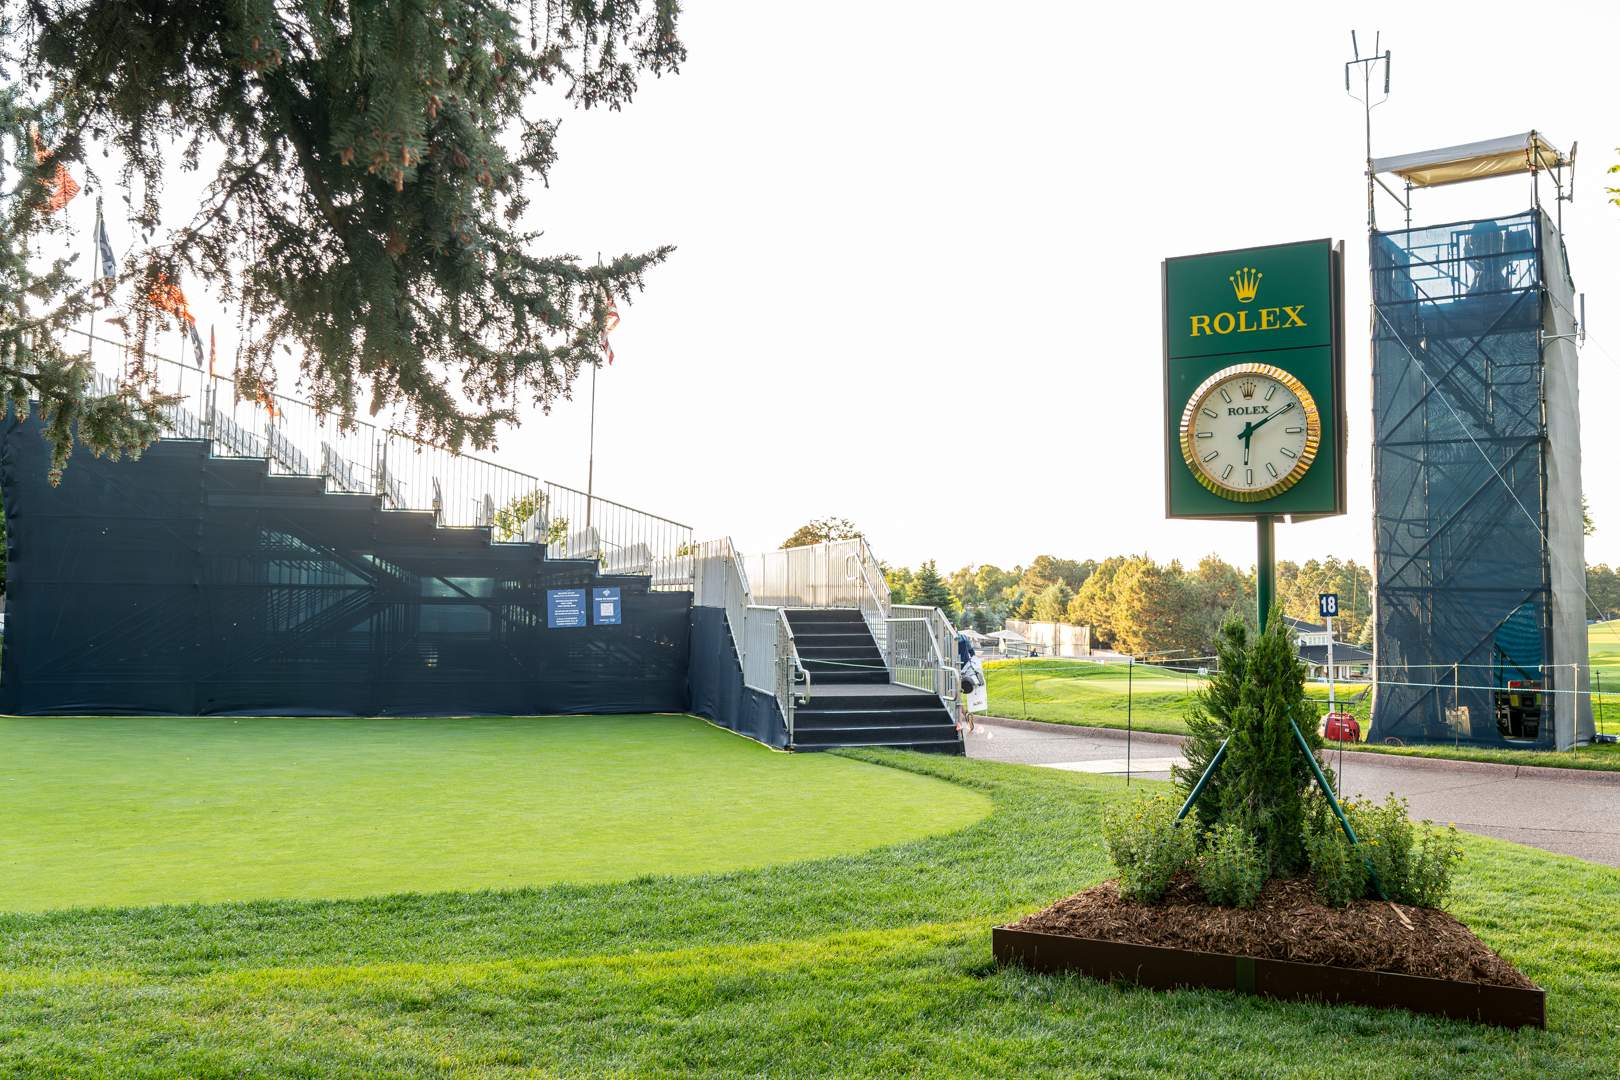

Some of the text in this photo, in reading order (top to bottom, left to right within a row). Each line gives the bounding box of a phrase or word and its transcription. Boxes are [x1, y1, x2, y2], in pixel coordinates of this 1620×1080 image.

[1190, 305, 1306, 336] ROLEX
[1228, 405, 1269, 416] ROLEX
[1321, 596, 1336, 613] 18
